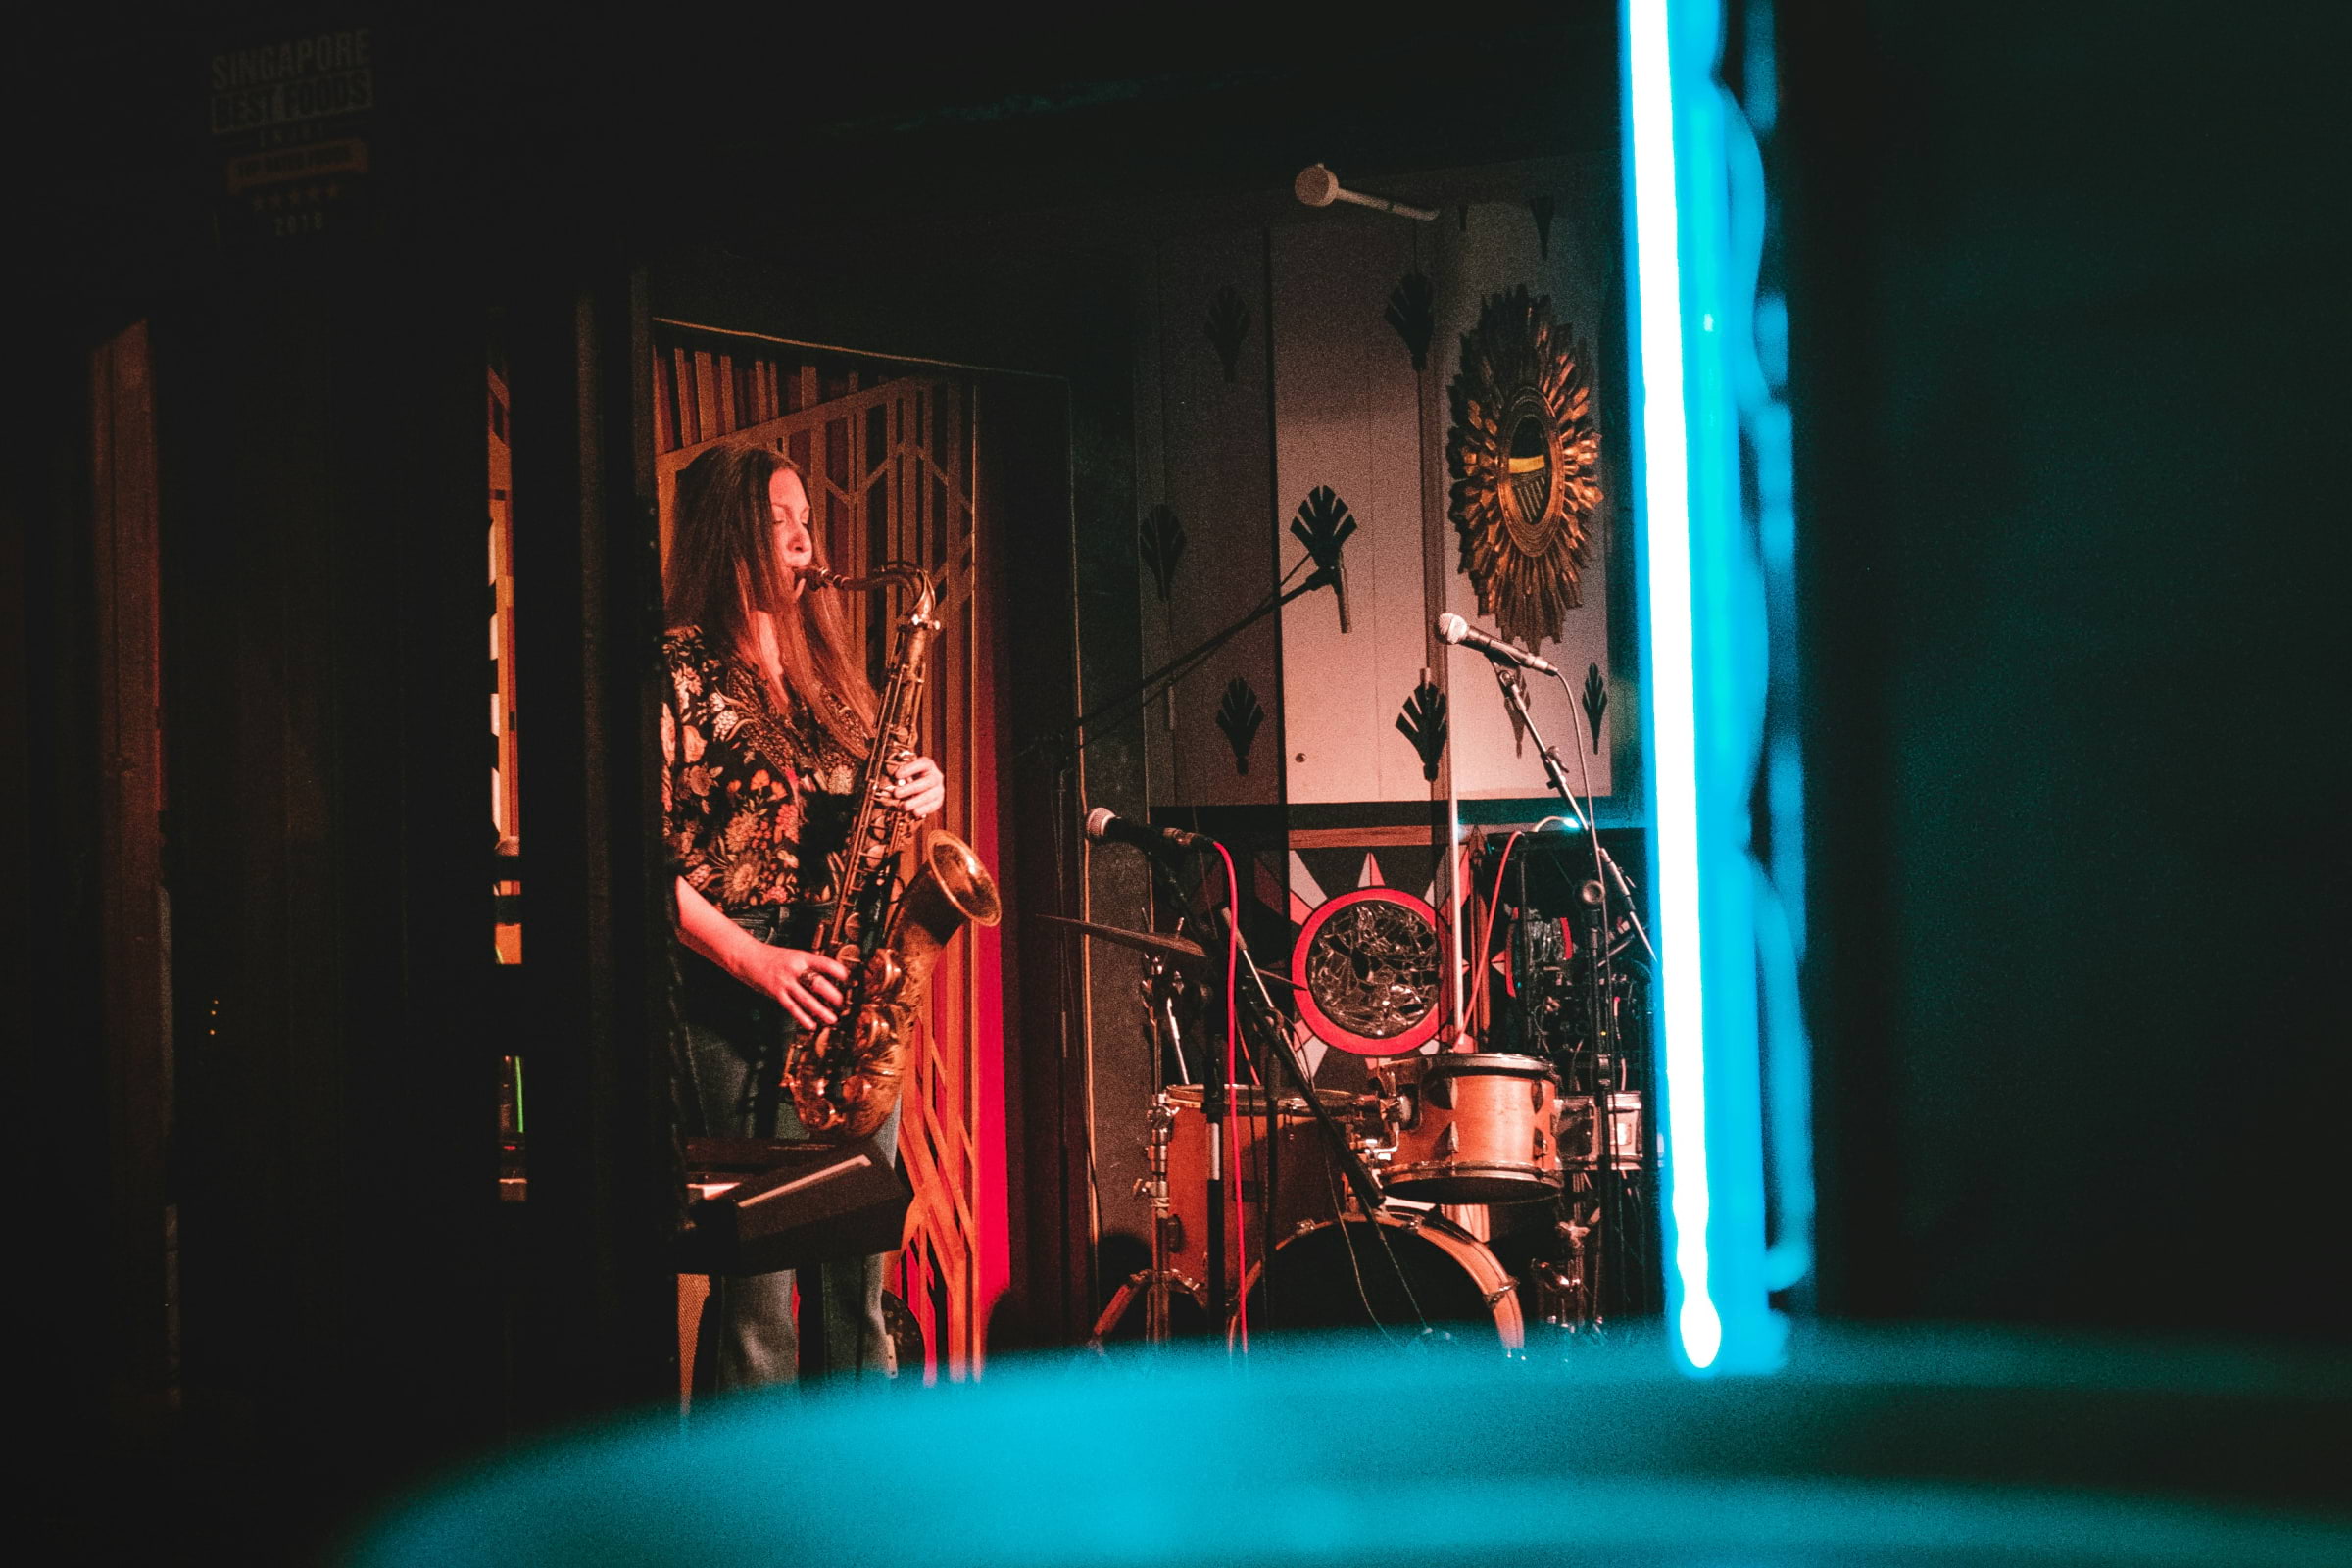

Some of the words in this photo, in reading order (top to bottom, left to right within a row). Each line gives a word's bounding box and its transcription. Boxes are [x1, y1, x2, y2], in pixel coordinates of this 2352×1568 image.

[211, 29, 370, 89] SINGAPORE
[215, 86, 274, 127] BEST
[285, 71, 367, 117] FOODS
[273, 212, 323, 236] 2018
